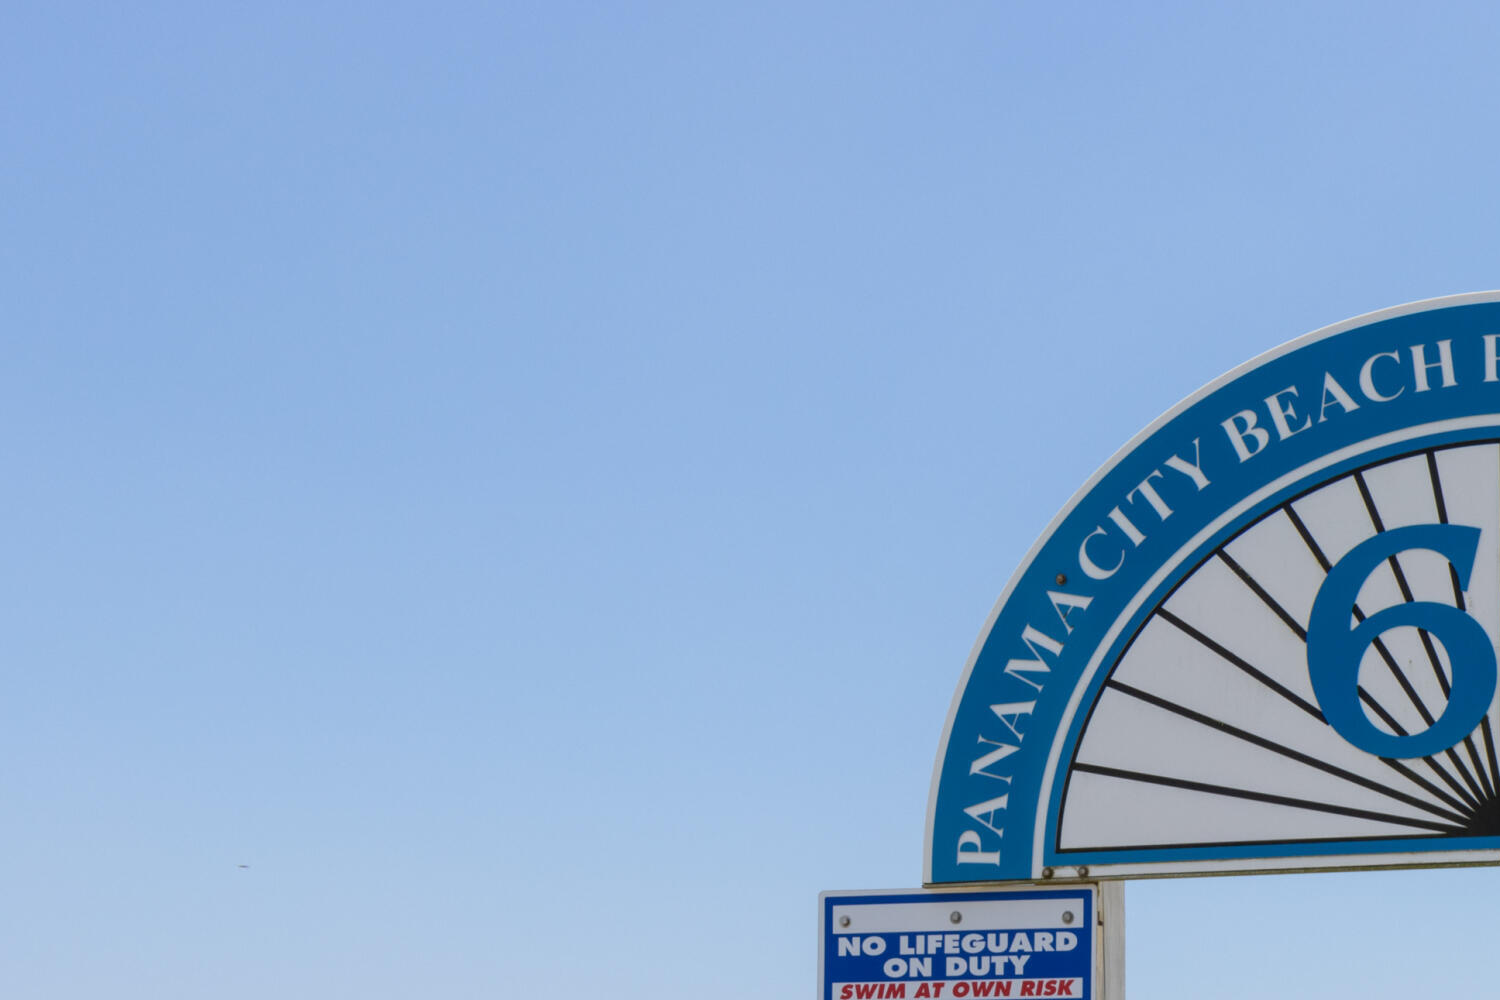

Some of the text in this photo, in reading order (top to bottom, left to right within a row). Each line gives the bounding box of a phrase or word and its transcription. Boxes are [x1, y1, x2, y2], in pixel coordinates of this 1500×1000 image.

[956, 589, 1094, 866] PANAMA
[1078, 437, 1211, 580] CITY
[1220, 339, 1459, 464] BEACH
[838, 931, 1077, 956] NO LIFEGUARD
[883, 954, 1030, 978] ON DUTY
[839, 979, 1074, 1000] SWIM AT OWN RISK
